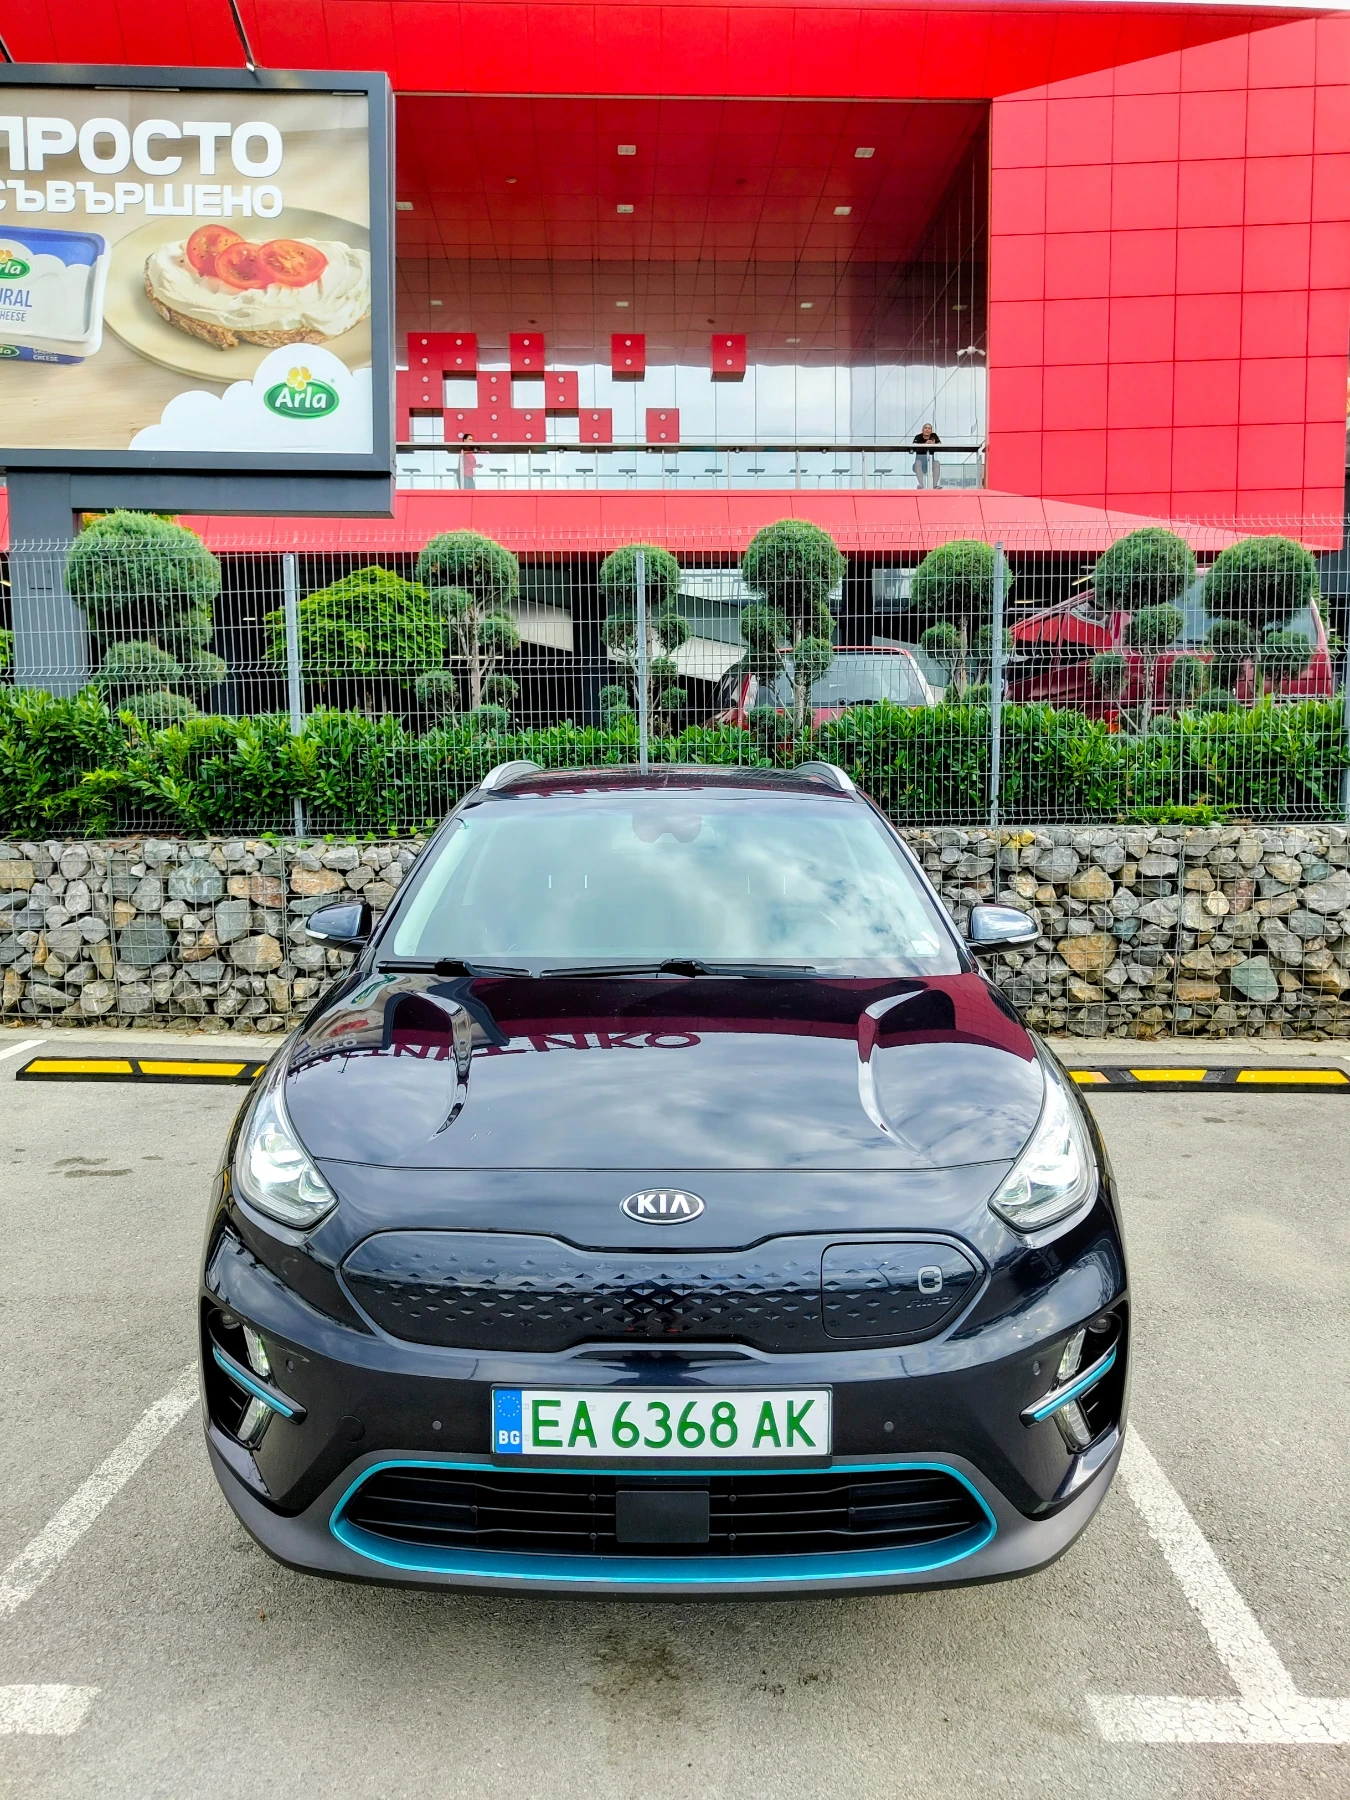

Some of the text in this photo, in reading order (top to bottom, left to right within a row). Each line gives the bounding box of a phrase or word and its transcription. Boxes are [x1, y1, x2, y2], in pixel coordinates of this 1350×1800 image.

[0, 180, 283, 218] ЪВЪРШЕНО
[0, 261, 21, 275] rla
[0, 310, 27, 322] HEESE
[274, 386, 327, 409] Arla
[636, 1194, 692, 1214] KIA
[531, 1399, 817, 1449] EA 6368 AK
[498, 1429, 520, 1446] BG
